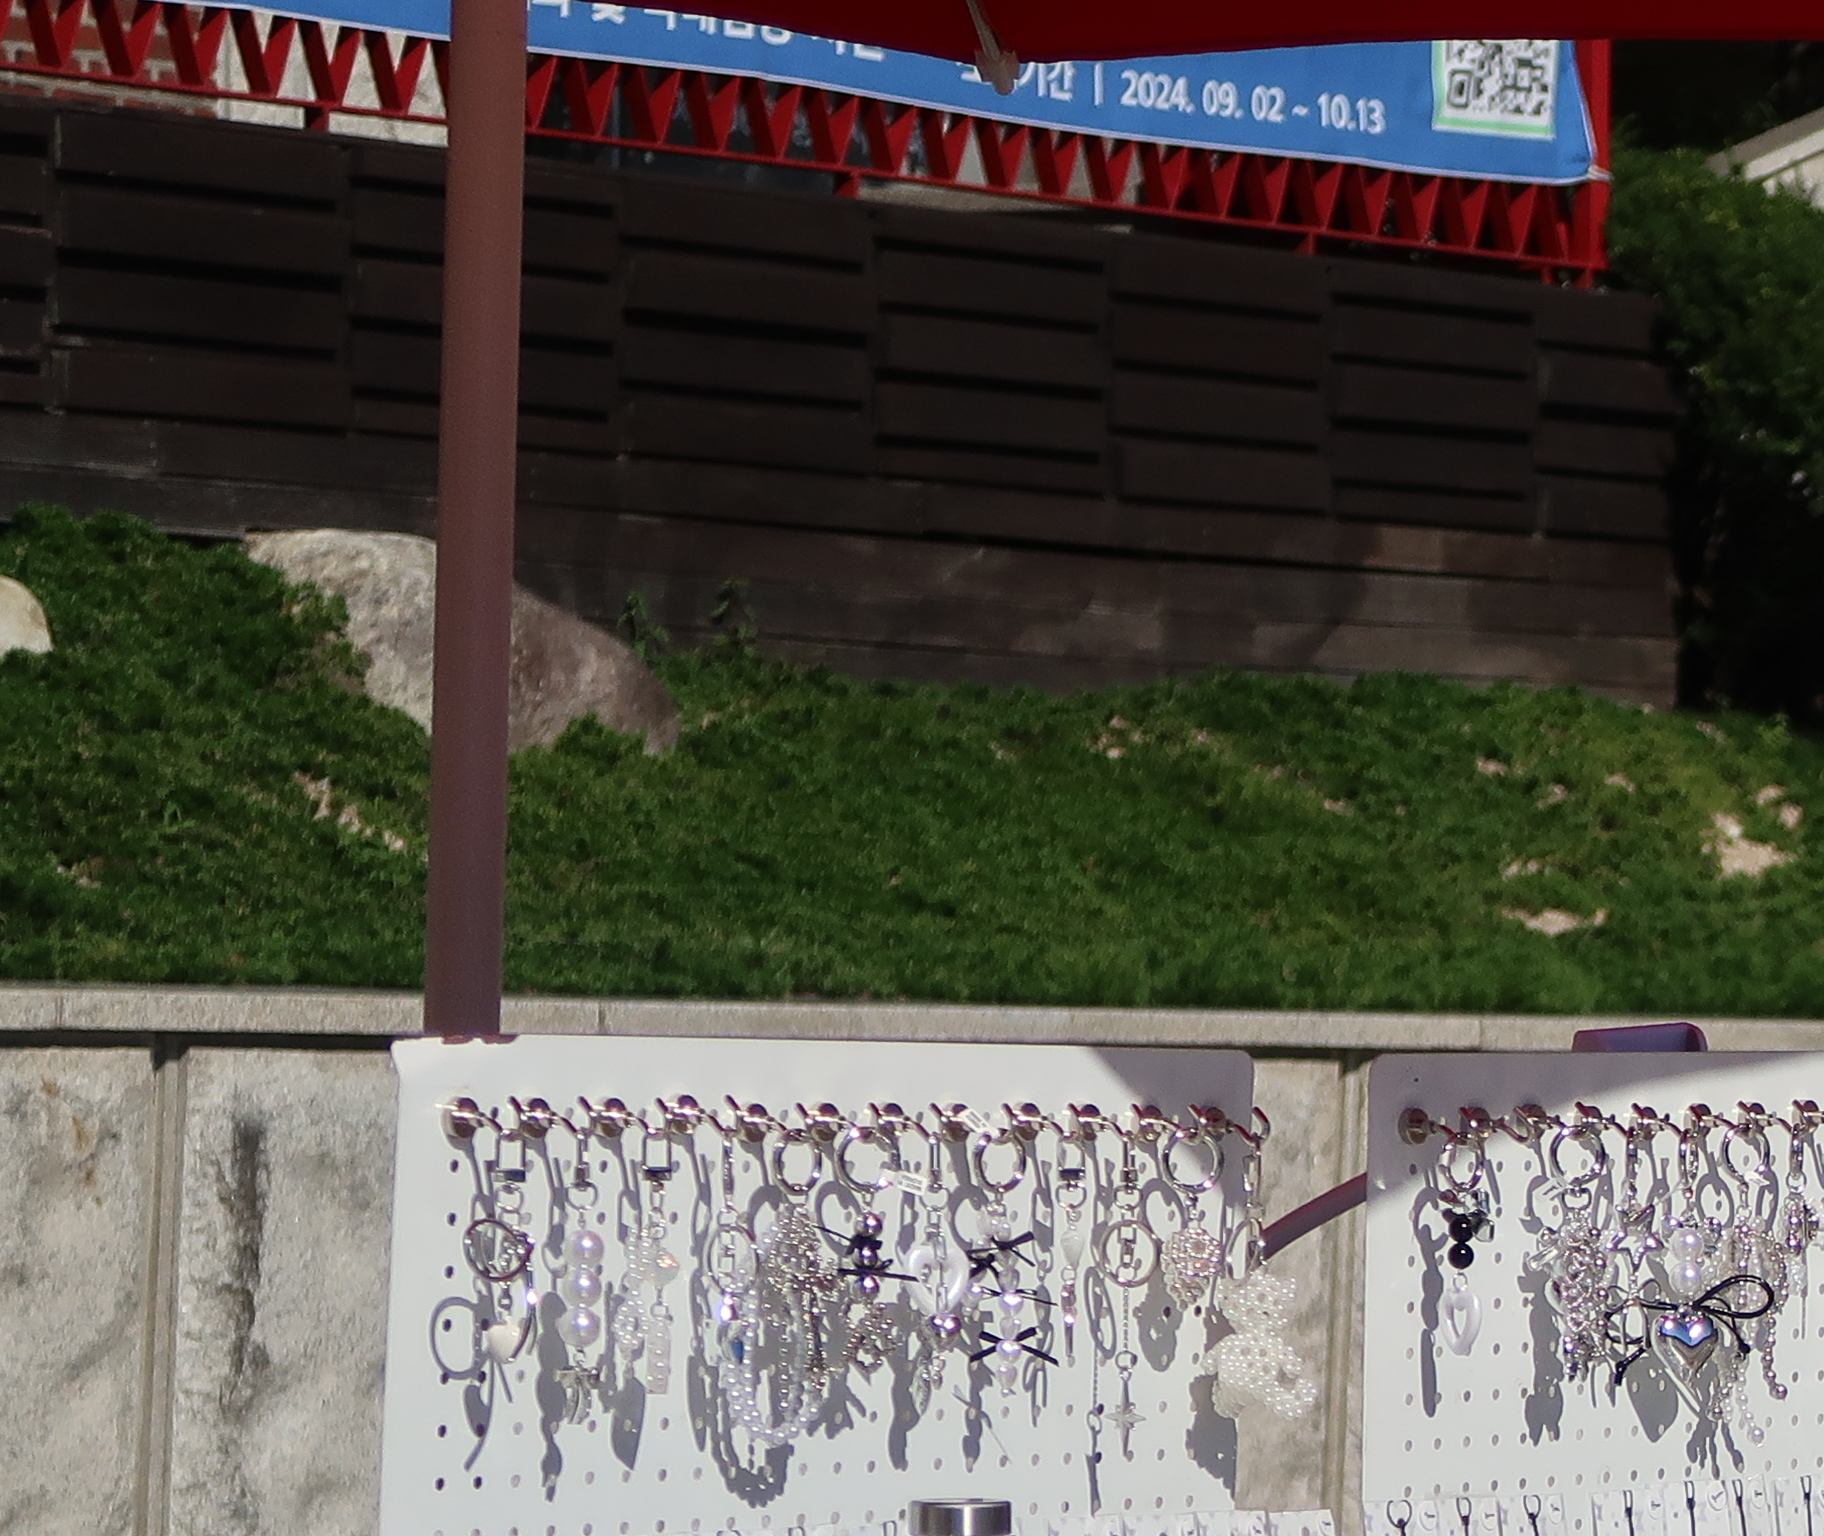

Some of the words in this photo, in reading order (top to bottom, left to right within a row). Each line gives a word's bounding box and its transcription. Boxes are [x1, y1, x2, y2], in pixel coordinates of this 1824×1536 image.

[1120, 68, 1196, 114] 2024.
[1202, 80, 1244, 119] 09.
[1251, 85, 1287, 124] 02
[1315, 92, 1387, 135] 10.13
